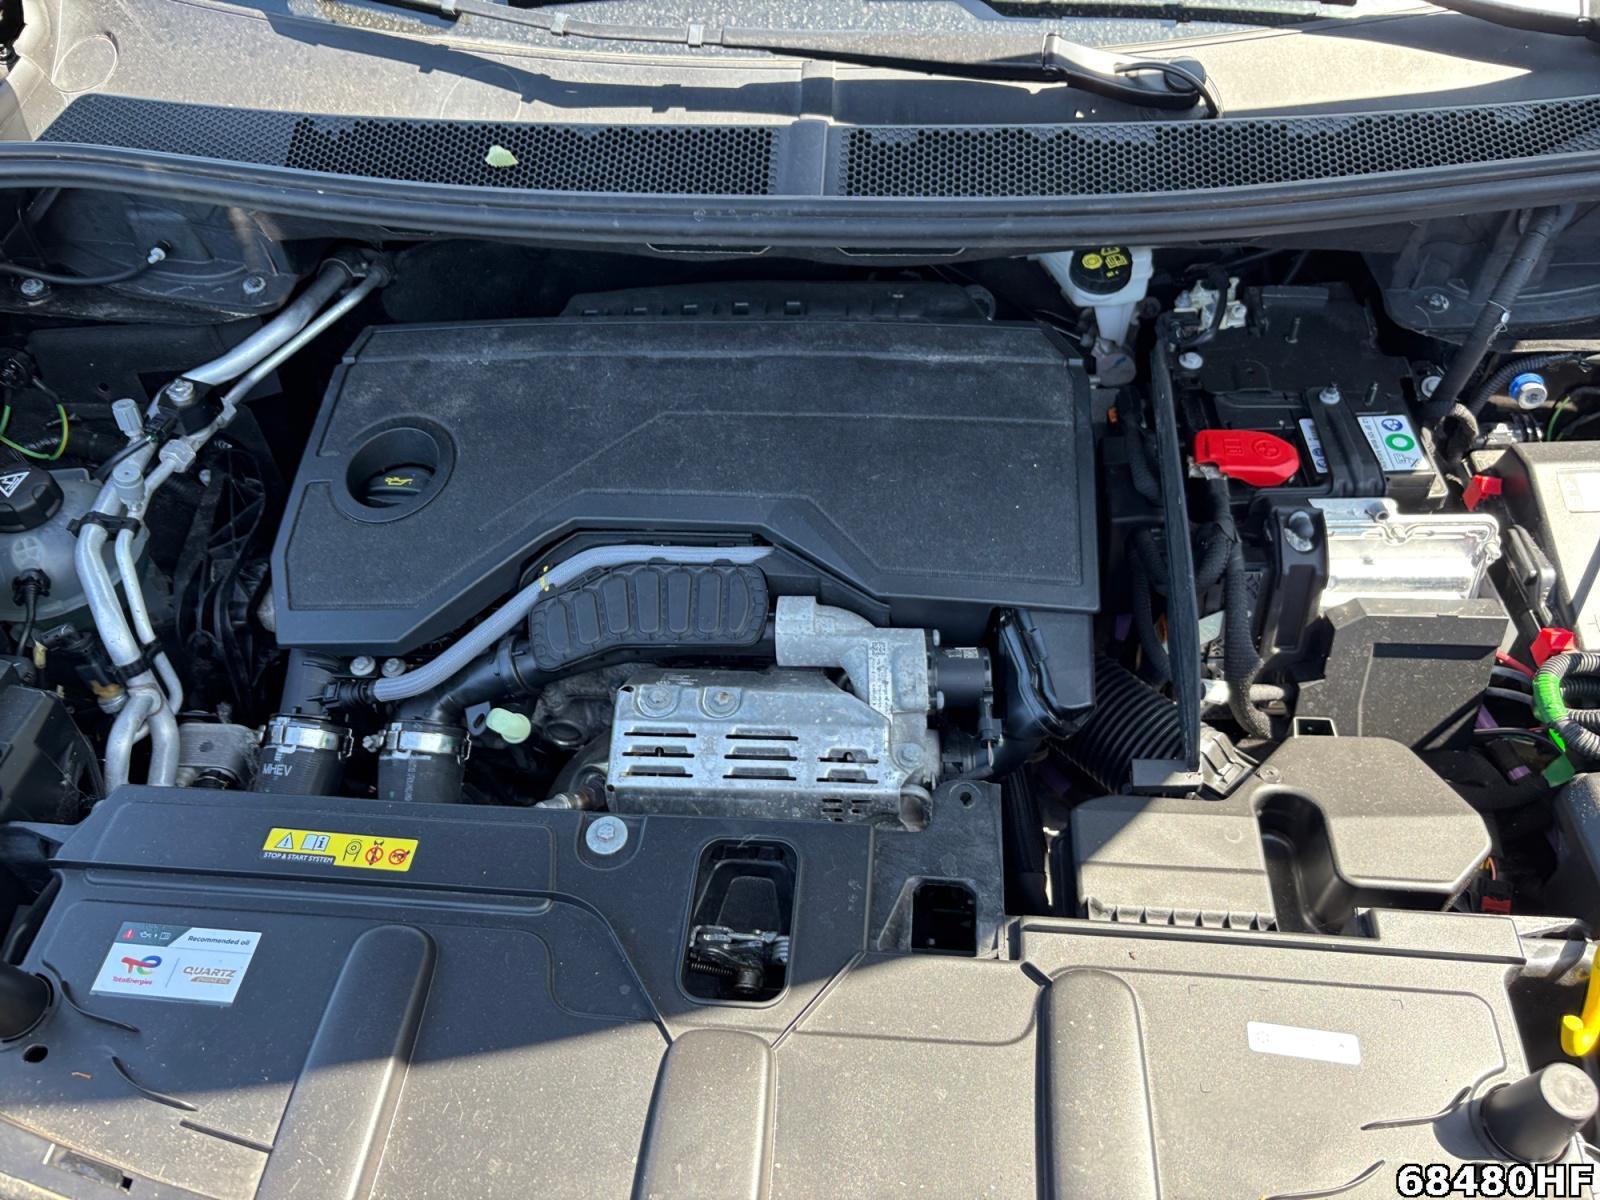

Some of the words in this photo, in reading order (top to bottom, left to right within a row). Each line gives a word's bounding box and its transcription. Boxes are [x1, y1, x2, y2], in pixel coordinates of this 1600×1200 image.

[262, 763, 293, 776] MHEV
[263, 851, 281, 859] STOP
[287, 853, 308, 861] START
[308, 855, 334, 863] SYSTEM
[188, 935, 240, 945] Recommended
[183, 966, 237, 978] QUARTZ
